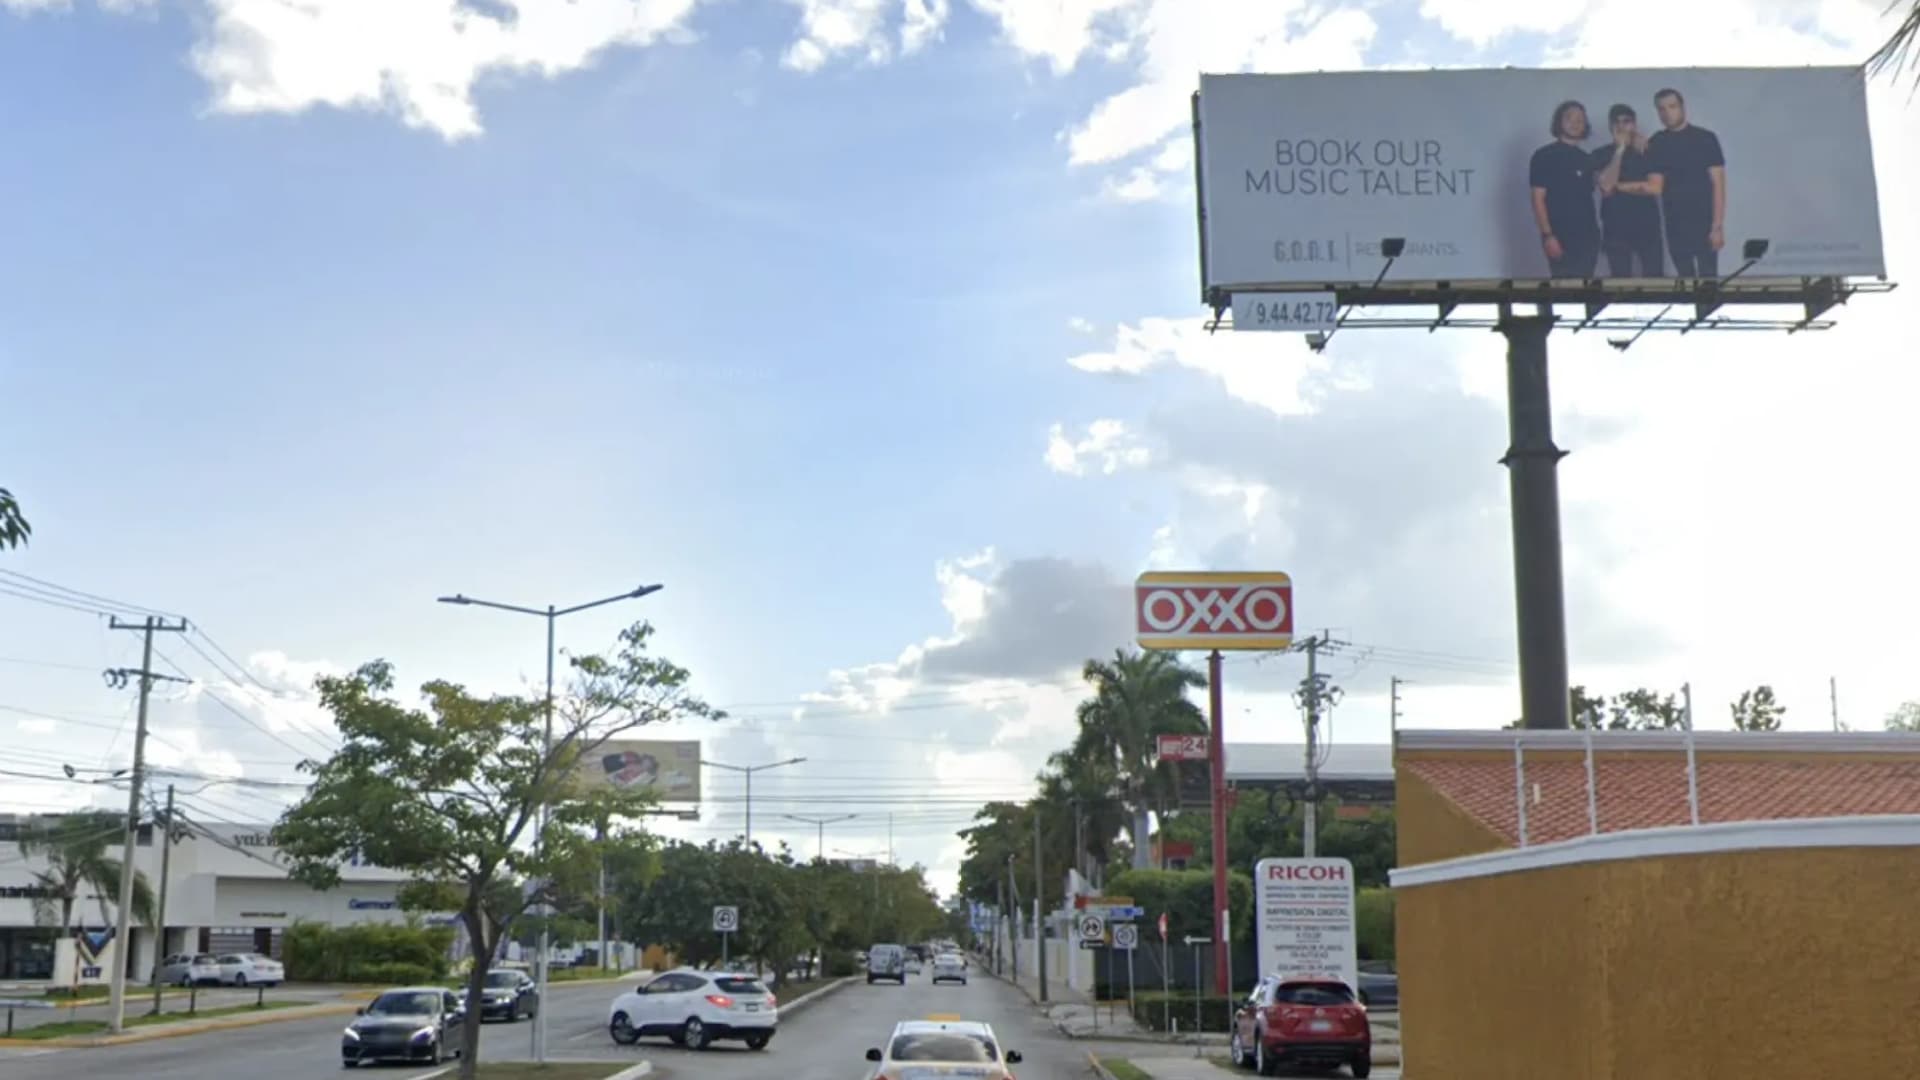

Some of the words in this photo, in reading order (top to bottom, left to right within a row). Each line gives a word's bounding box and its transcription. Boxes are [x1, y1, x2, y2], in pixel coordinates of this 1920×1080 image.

[1275, 139, 1365, 166] BOOK
[1374, 139, 1443, 166] OUR
[1245, 168, 1350, 196] MUSIC
[1357, 168, 1476, 196] TALENT
[1257, 302, 1335, 324] 9.44.42.72
[1143, 588, 1287, 632] OXXO
[1183, 737, 1206, 752] 24
[1269, 866, 1345, 881] RICOH
